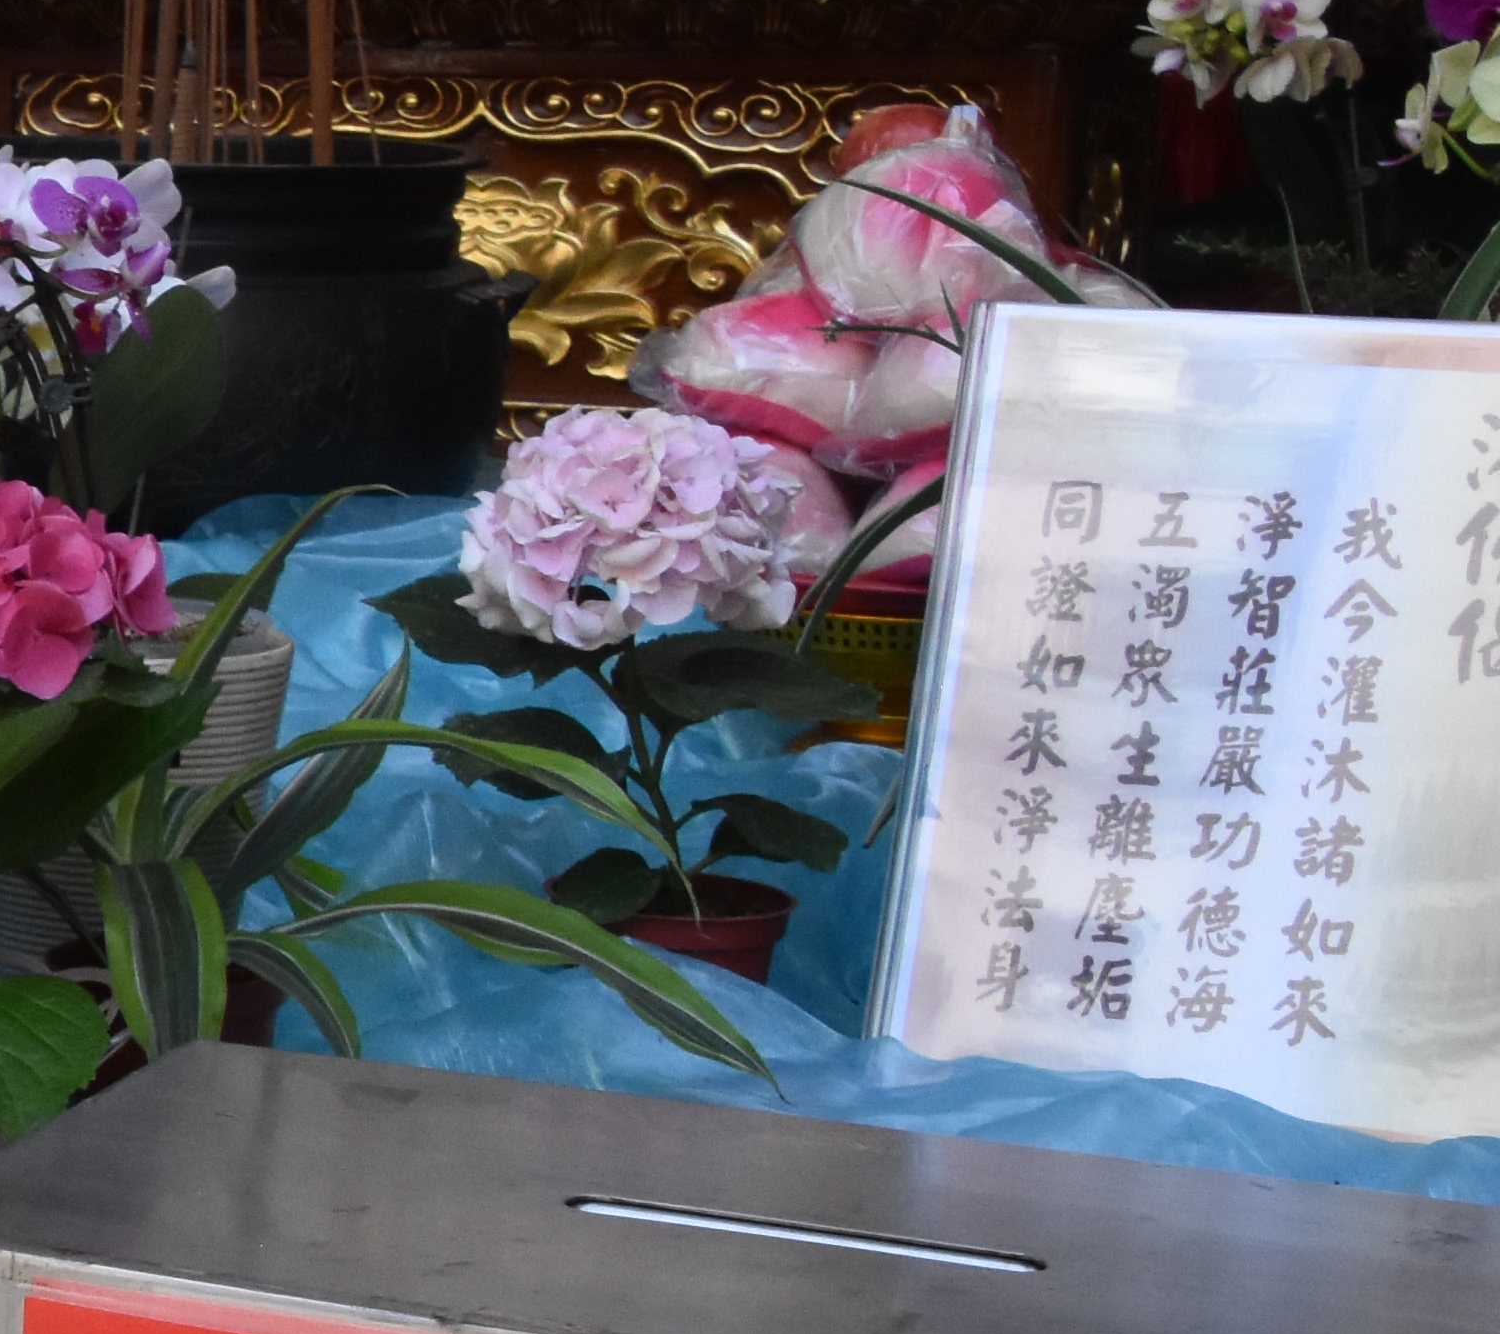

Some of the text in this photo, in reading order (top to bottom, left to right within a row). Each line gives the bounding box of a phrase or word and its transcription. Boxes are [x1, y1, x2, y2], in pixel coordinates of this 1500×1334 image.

[976, 479, 1102, 1012] 同證如來淨法身
[1165, 491, 1304, 1033] 淨智莊嚴功德海
[1270, 501, 1404, 1048] 我今灌沐諸如來
